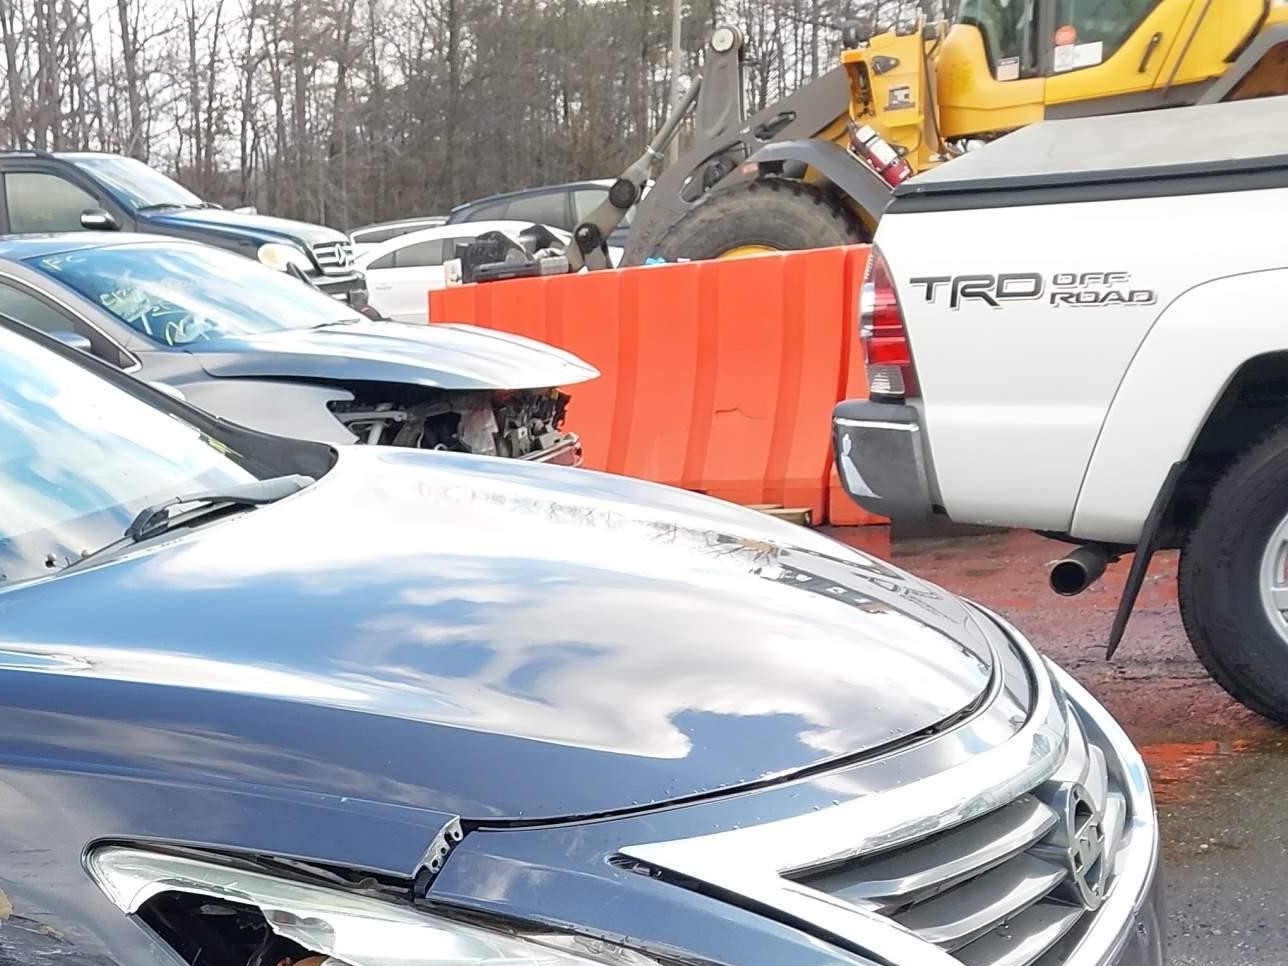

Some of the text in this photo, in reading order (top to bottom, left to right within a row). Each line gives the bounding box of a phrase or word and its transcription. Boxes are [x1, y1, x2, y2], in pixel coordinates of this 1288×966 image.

[1052, 271, 1132, 287] OFF
[909, 272, 1046, 311] TRD
[1049, 289, 1157, 307] ROAD
